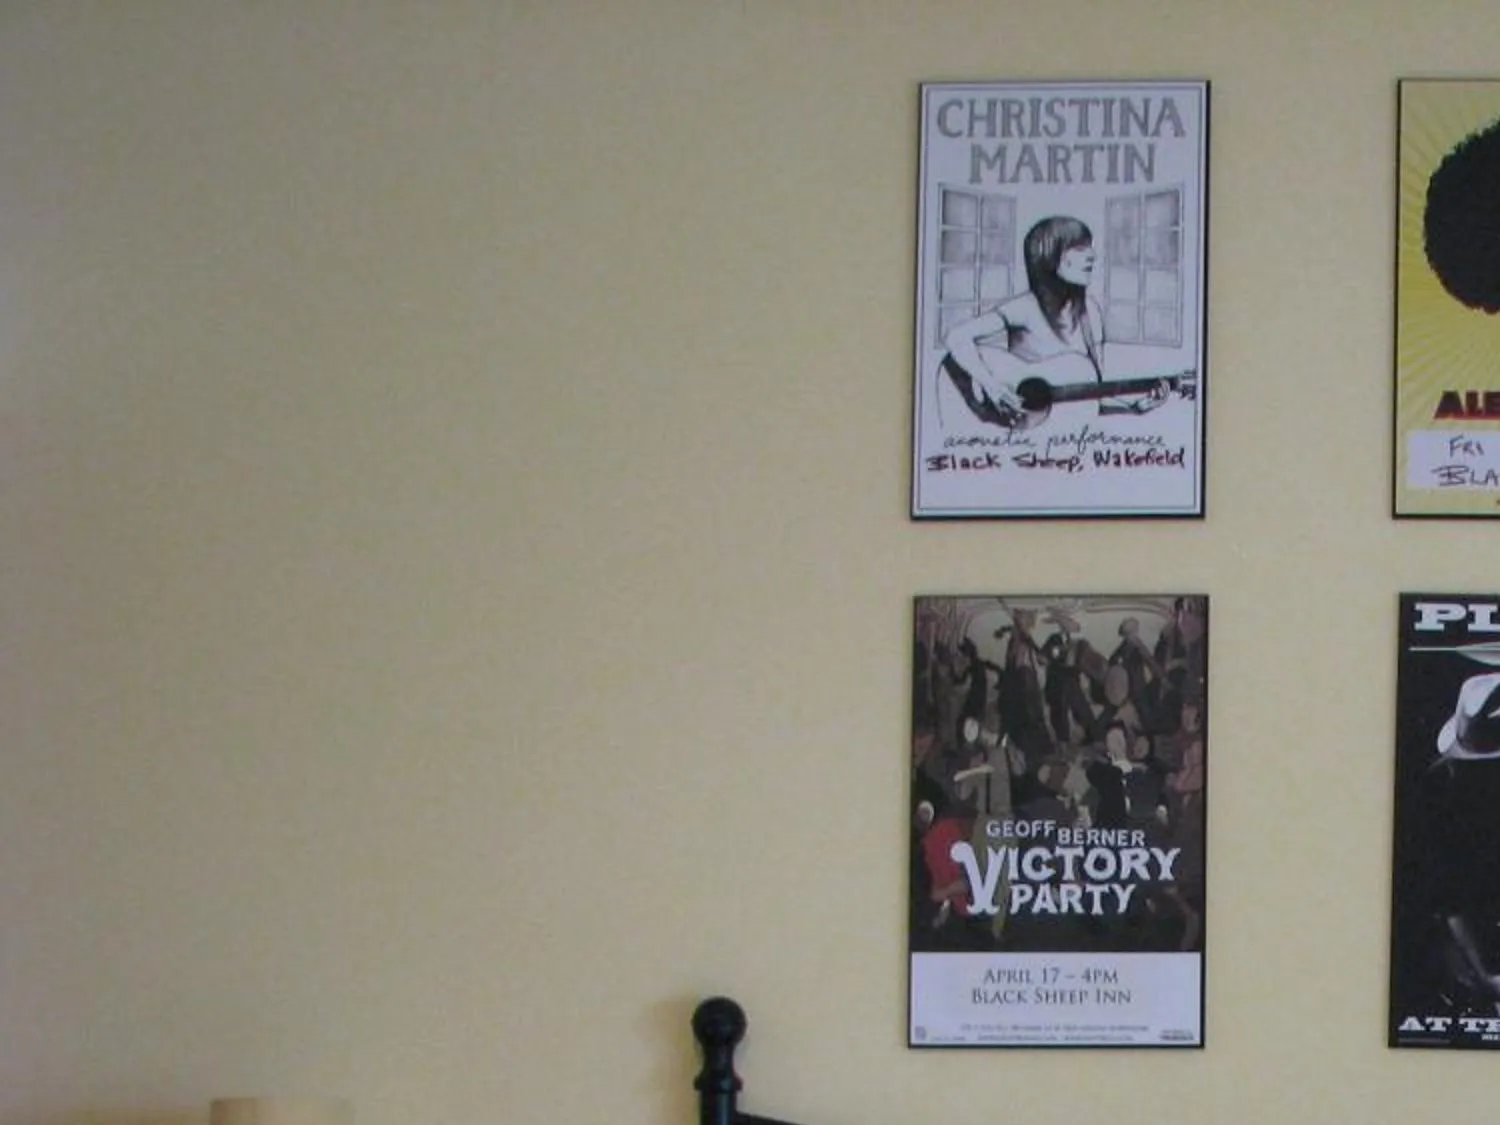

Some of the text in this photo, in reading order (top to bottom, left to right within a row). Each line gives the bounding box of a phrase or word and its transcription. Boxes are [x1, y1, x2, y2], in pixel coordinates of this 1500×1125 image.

[937, 96, 1187, 139] CHRISTINA
[967, 143, 1157, 184] MARTIN
[1047, 424, 1166, 457] performance
[1092, 447, 1186, 468] Wakefield
[985, 818, 1146, 847] GEOFF BERNER
[950, 840, 1182, 915] VICTORY
[1009, 883, 1137, 916] PARTY
[983, 967, 1032, 985] APRIL
[1040, 966, 1061, 985] 17
[1080, 967, 1120, 985] 4PM
[971, 986, 1133, 1006] BLACK SHEEP INN
[1398, 1016, 1453, 1032] AT
